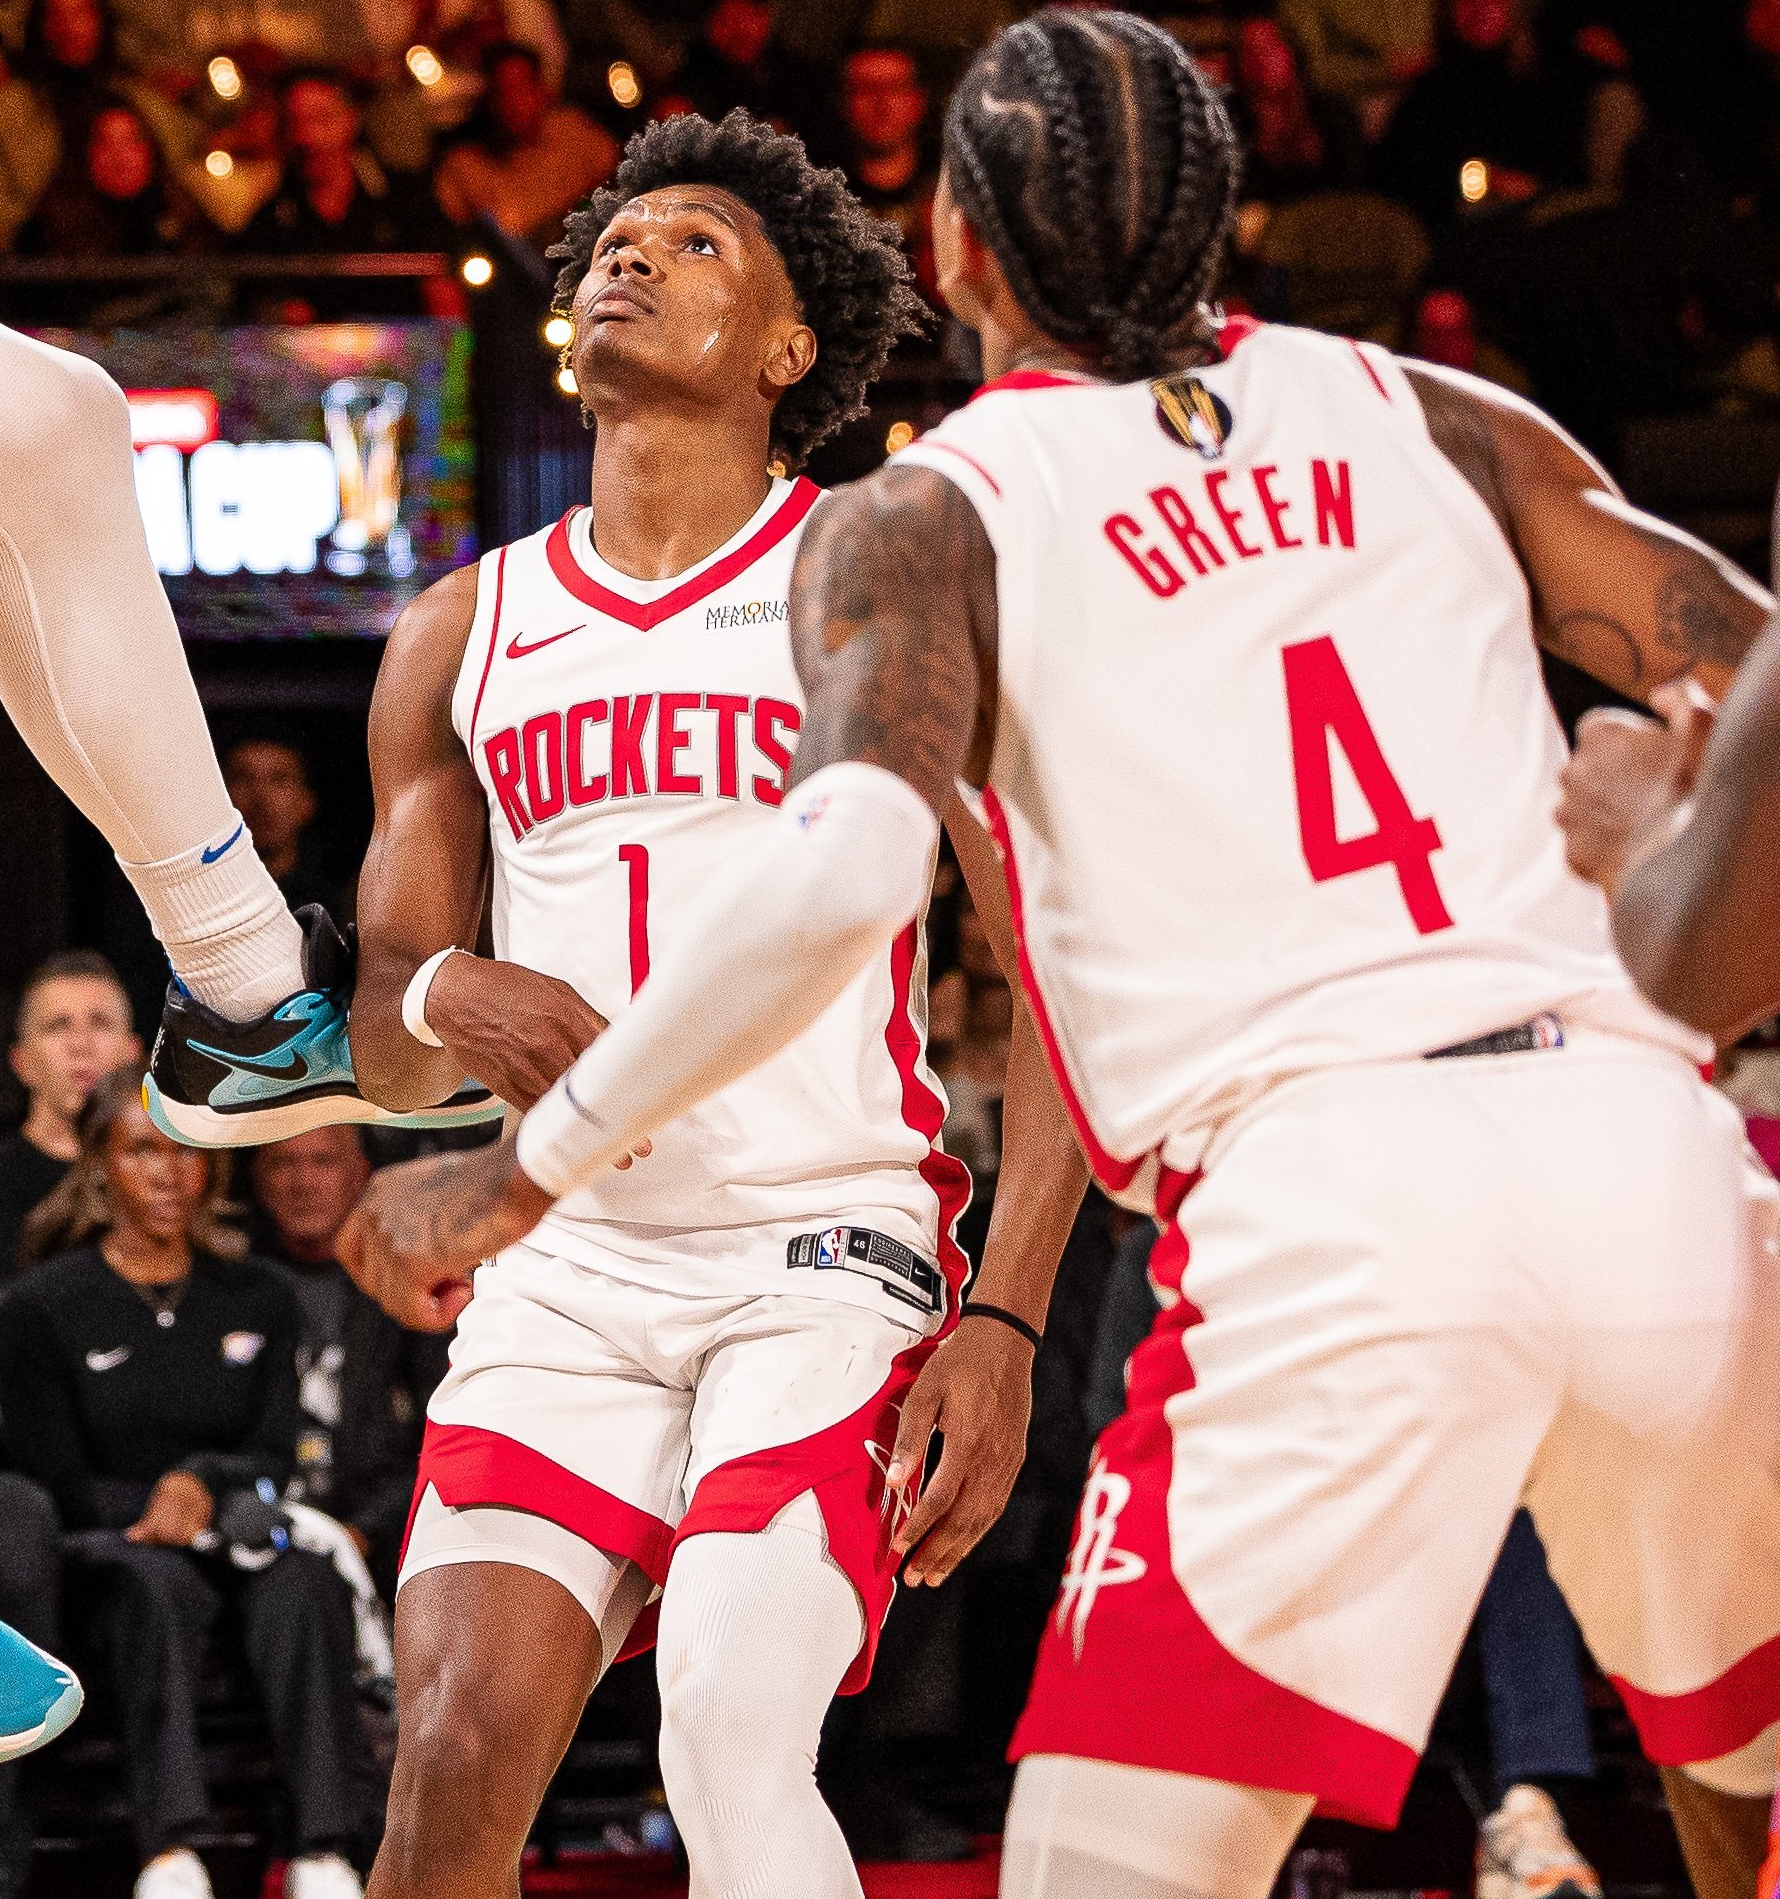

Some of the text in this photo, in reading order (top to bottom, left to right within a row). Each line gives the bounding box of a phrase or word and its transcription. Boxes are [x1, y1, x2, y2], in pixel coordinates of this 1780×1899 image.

[1103, 456, 1357, 600] GREEN
[483, 692, 804, 845] ROCKETS
[1282, 635, 1455, 935] 4
[618, 843, 651, 1005] 1
